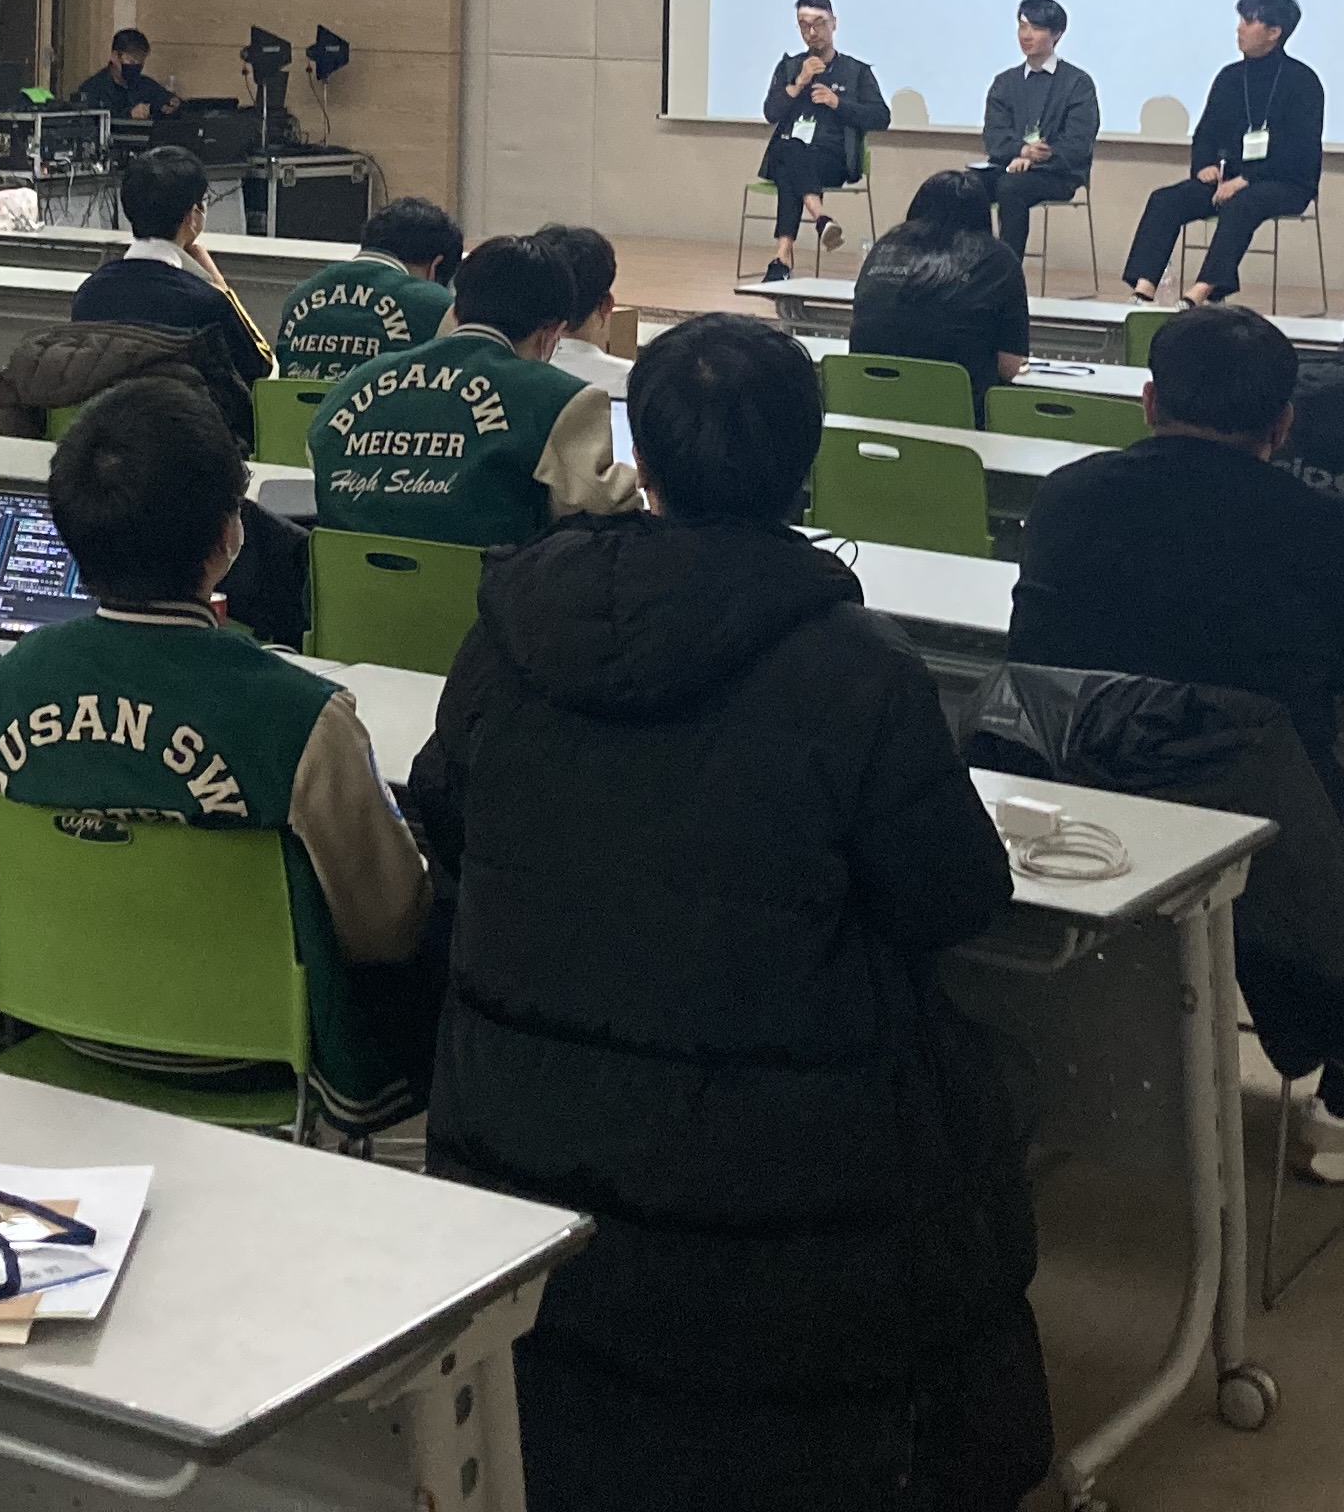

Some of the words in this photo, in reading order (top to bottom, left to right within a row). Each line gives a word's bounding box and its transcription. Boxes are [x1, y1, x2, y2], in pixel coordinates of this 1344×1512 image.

[374, 296, 411, 341] SW
[290, 335, 380, 356] MEISTER
[328, 364, 463, 435] BUSAN
[460, 376, 509, 435] SW
[344, 430, 465, 458] MEISTER
[330, 468, 382, 502] High
[384, 468, 458, 494] School
[162, 725, 248, 817] SW
